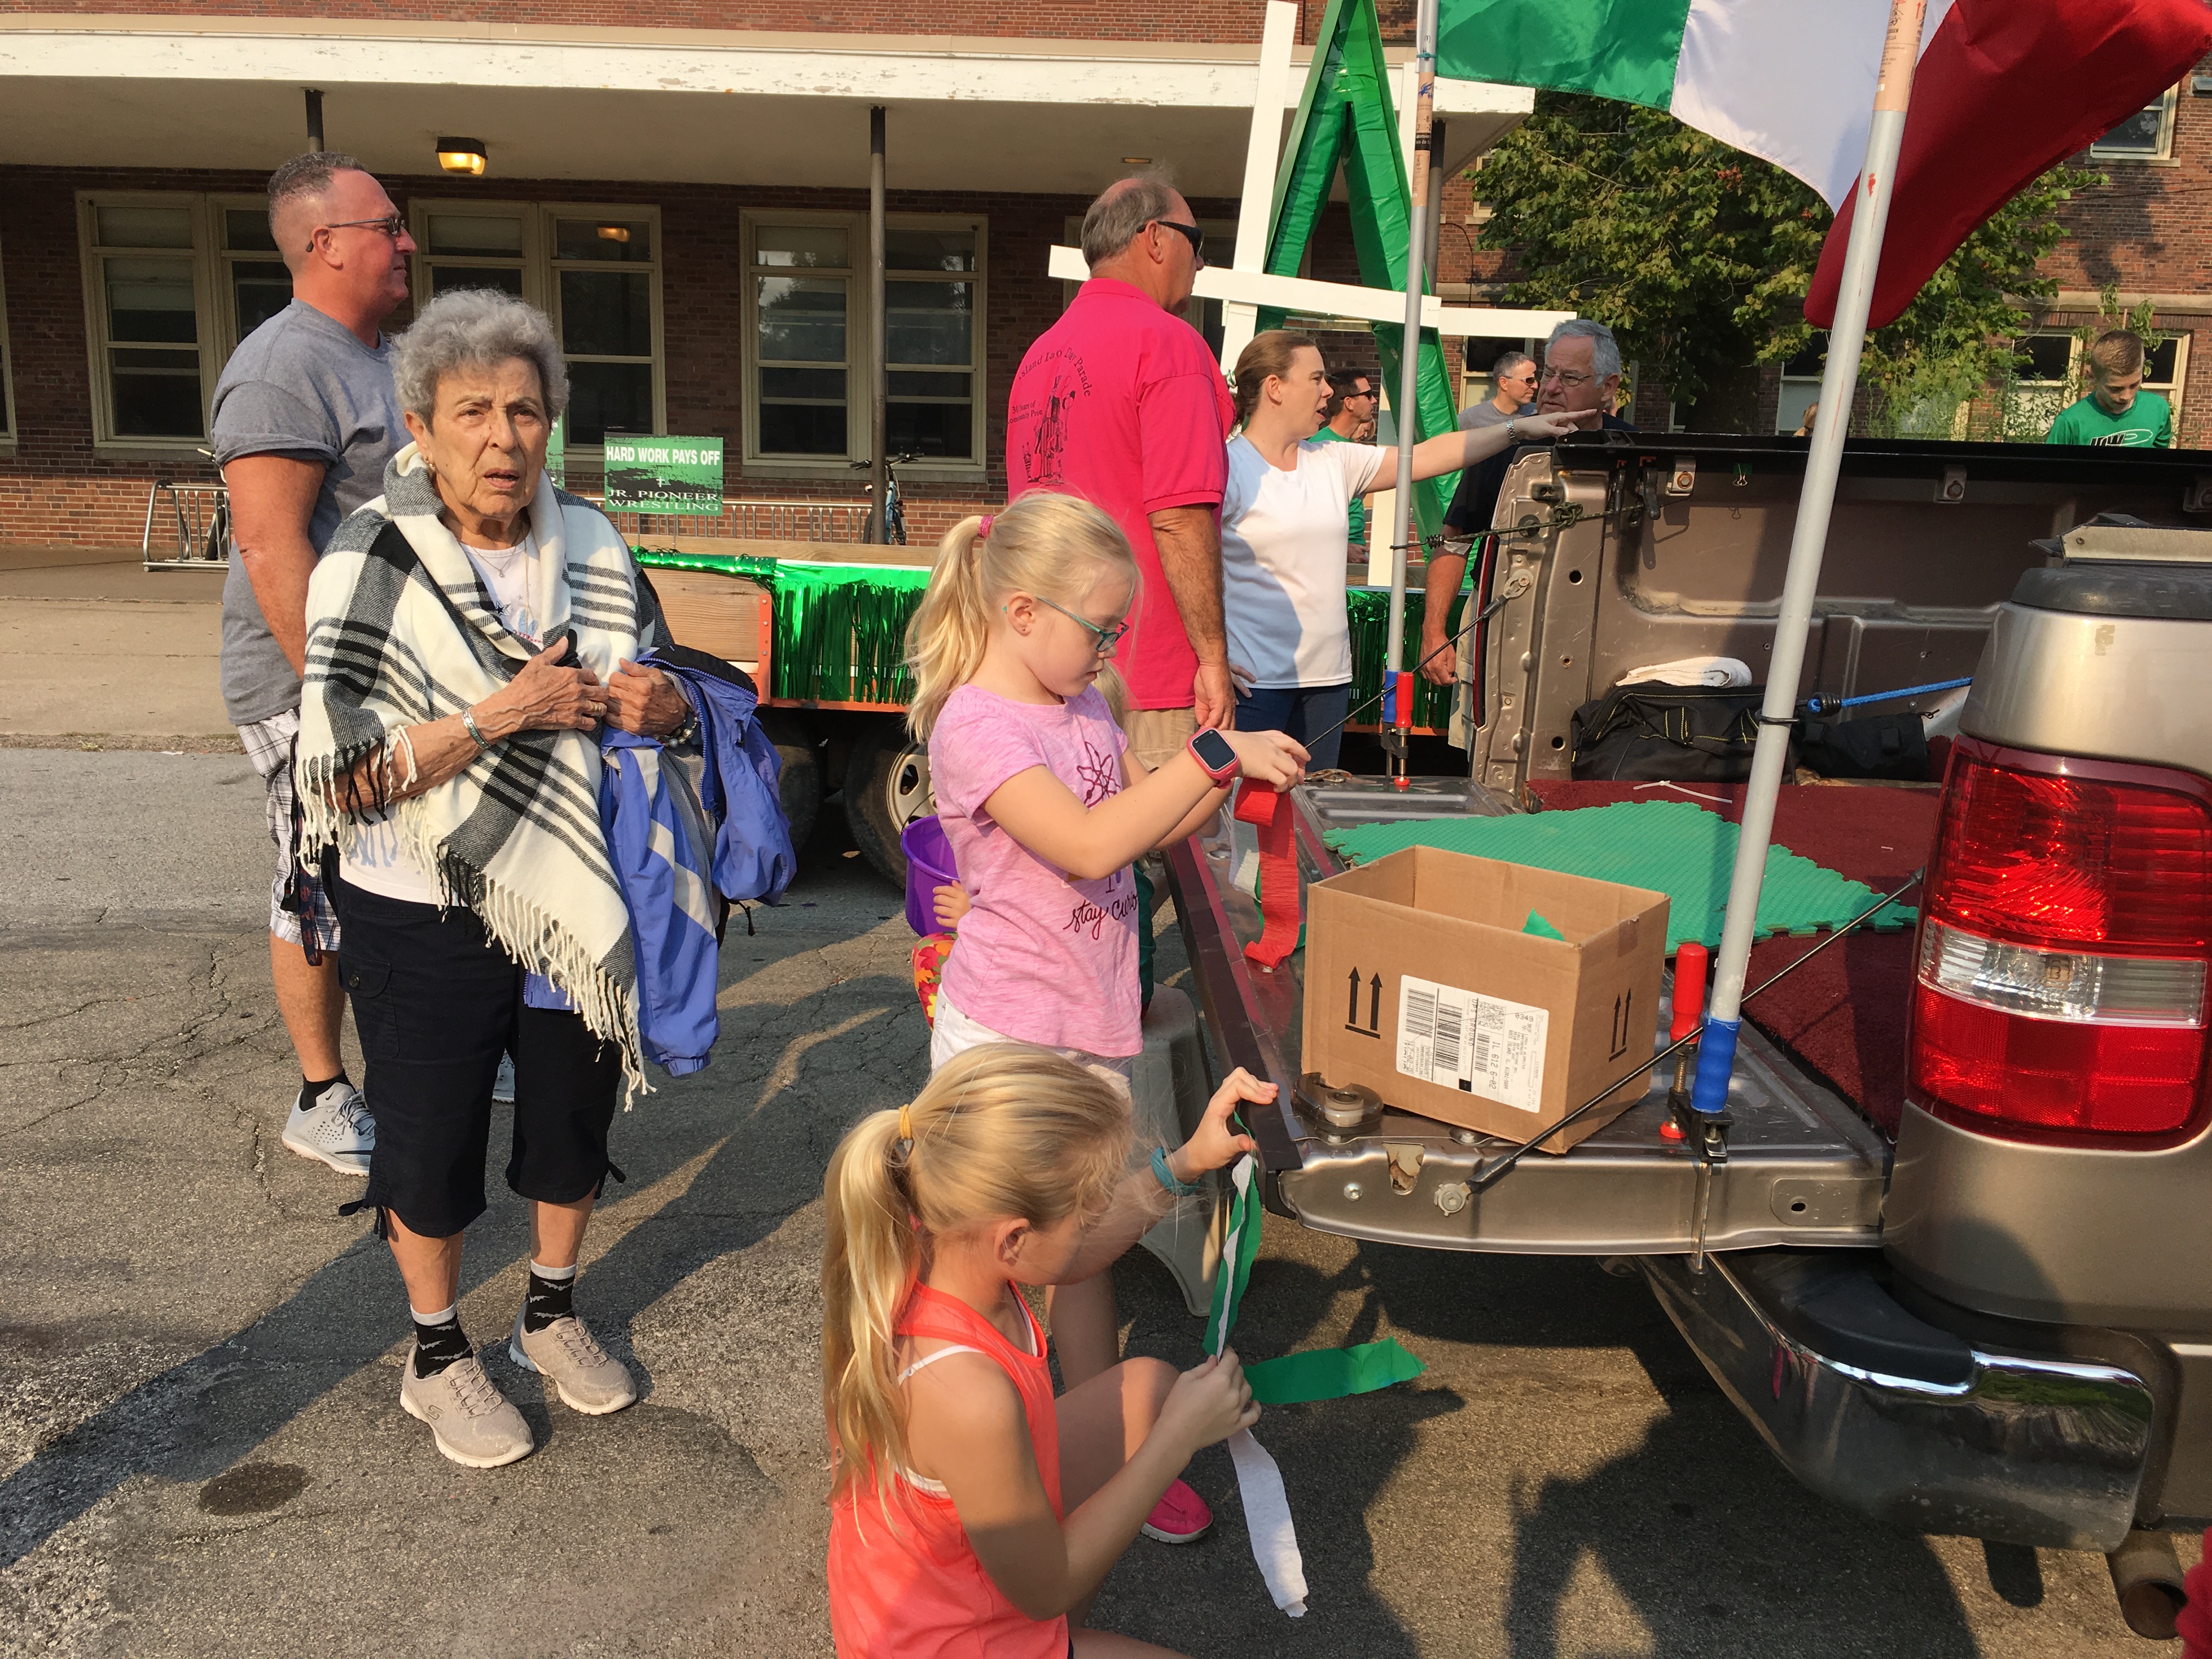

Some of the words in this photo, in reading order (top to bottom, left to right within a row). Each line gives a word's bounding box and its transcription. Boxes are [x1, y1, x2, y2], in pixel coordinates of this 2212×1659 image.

[1019, 356, 1042, 380] sland
[1074, 357, 1092, 397] Parade
[606, 446, 635, 461] HARD
[637, 447, 670, 464] WORK
[673, 449, 697, 465] PAYS
[700, 450, 720, 465] OFF
[608, 489, 632, 498] JR.
[638, 490, 718, 501] PIONEER
[608, 499, 718, 511] WRESTLING
[1063, 899, 1109, 940] stay
[1468, 1017, 1476, 1047] GROUND
[1492, 1041, 1500, 1051] IL
[1490, 1053, 1499, 1068] 612
[1488, 1070, 1497, 1090] 6-02
